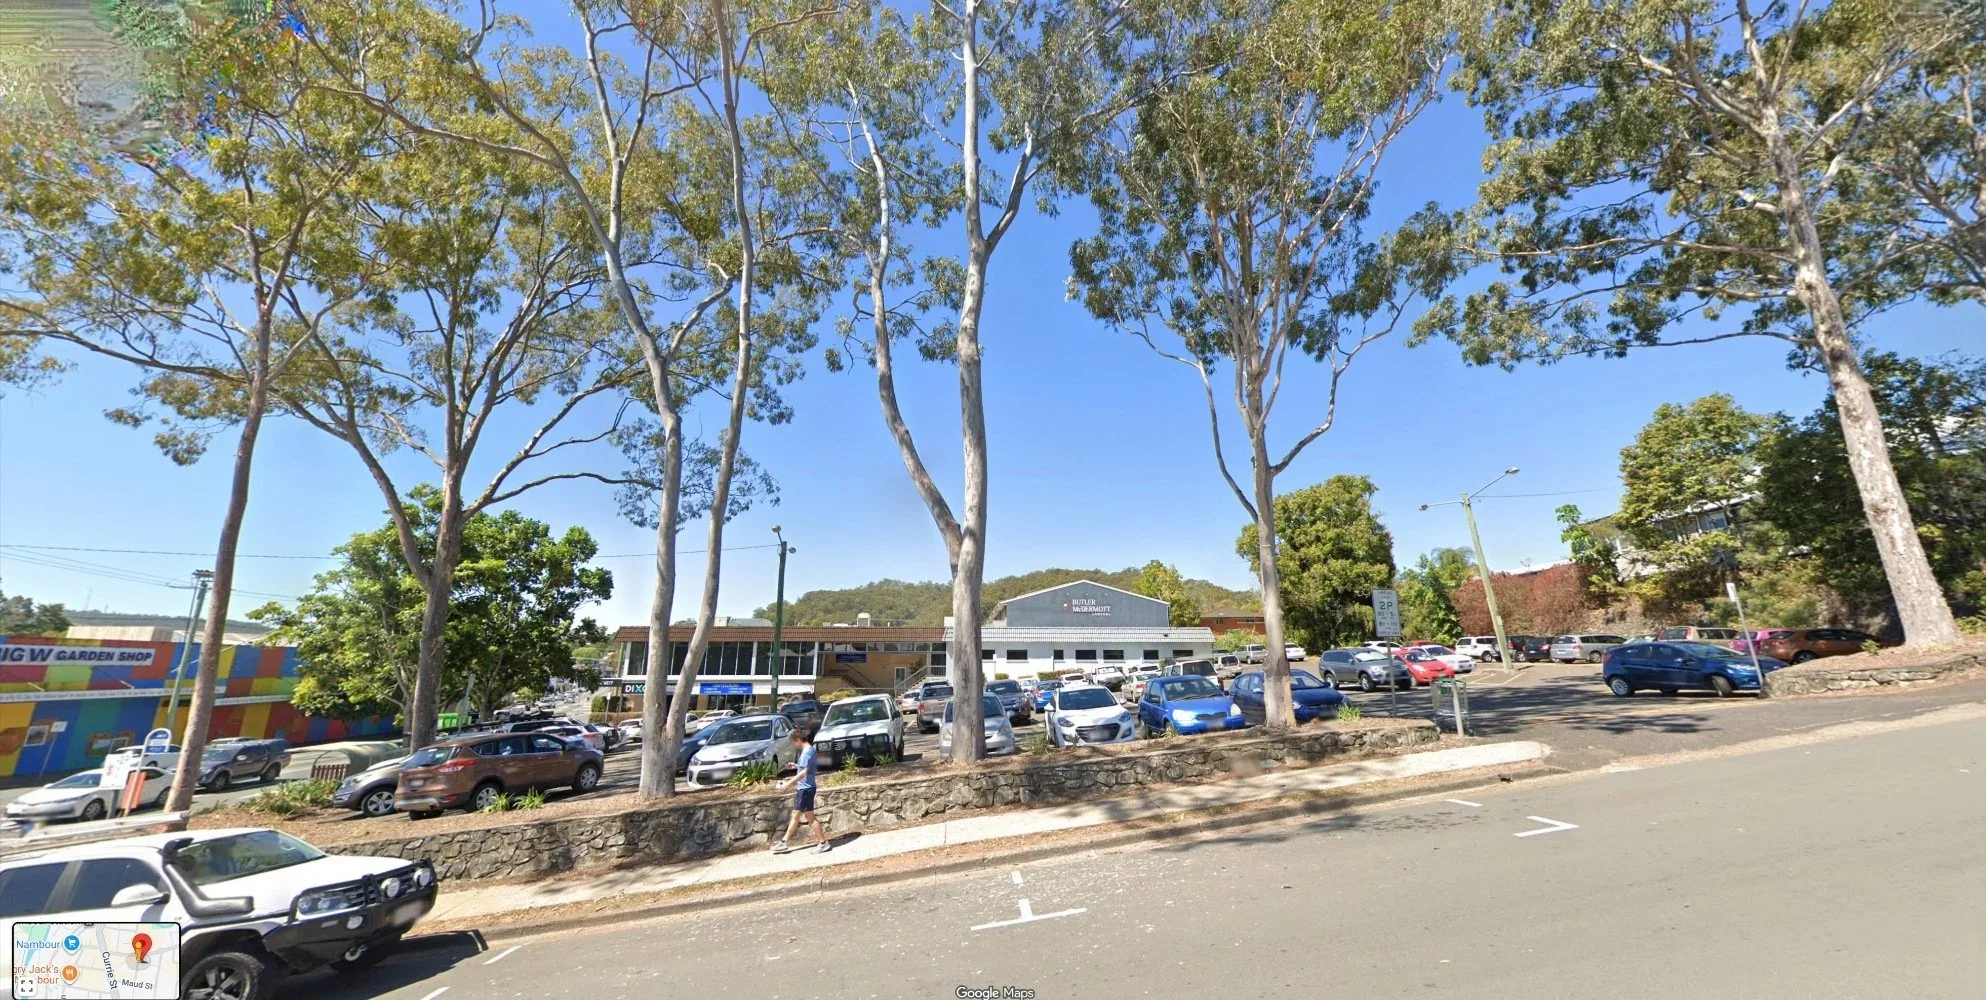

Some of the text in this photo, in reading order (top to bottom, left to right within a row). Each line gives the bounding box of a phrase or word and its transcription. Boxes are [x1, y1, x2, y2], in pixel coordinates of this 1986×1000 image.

[1380, 601, 1393, 610] 2P
[0, 647, 153, 662] IG W GARDEN SHOP
